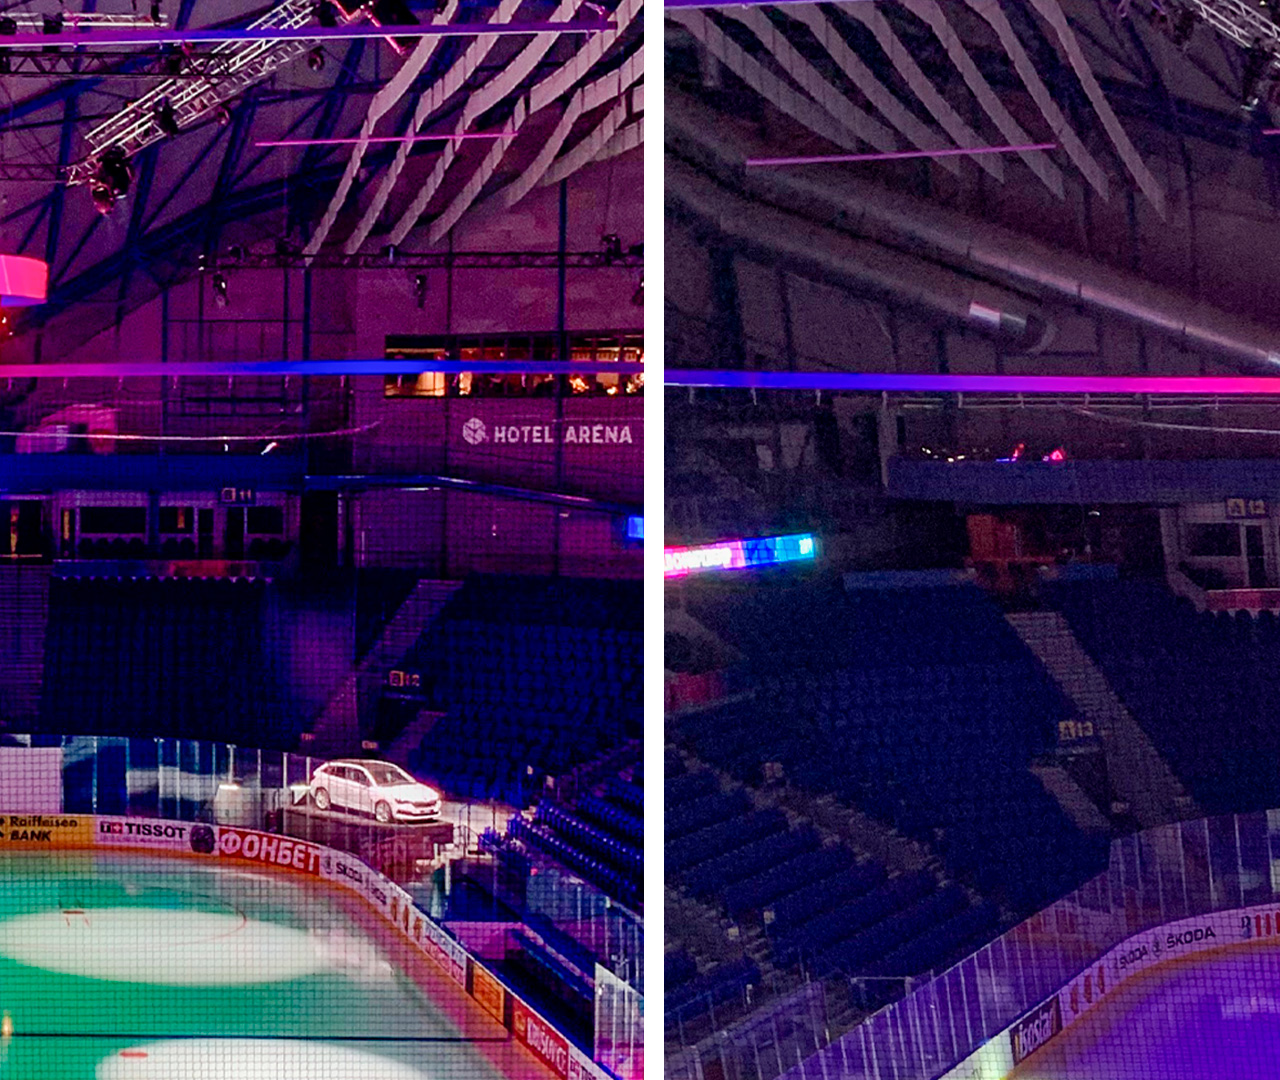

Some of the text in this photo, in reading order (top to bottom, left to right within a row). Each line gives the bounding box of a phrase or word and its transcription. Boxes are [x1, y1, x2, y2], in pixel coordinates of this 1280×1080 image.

[494, 426, 554, 443] HOTEL
[1076, 721, 1094, 737] 13
[10, 815, 78, 828] Raiffeisen
[10, 830, 52, 842] BANK
[125, 822, 187, 839] TISSOT
[220, 830, 321, 872] ФОНБЕТ
[1019, 1007, 1054, 1058] isostar
